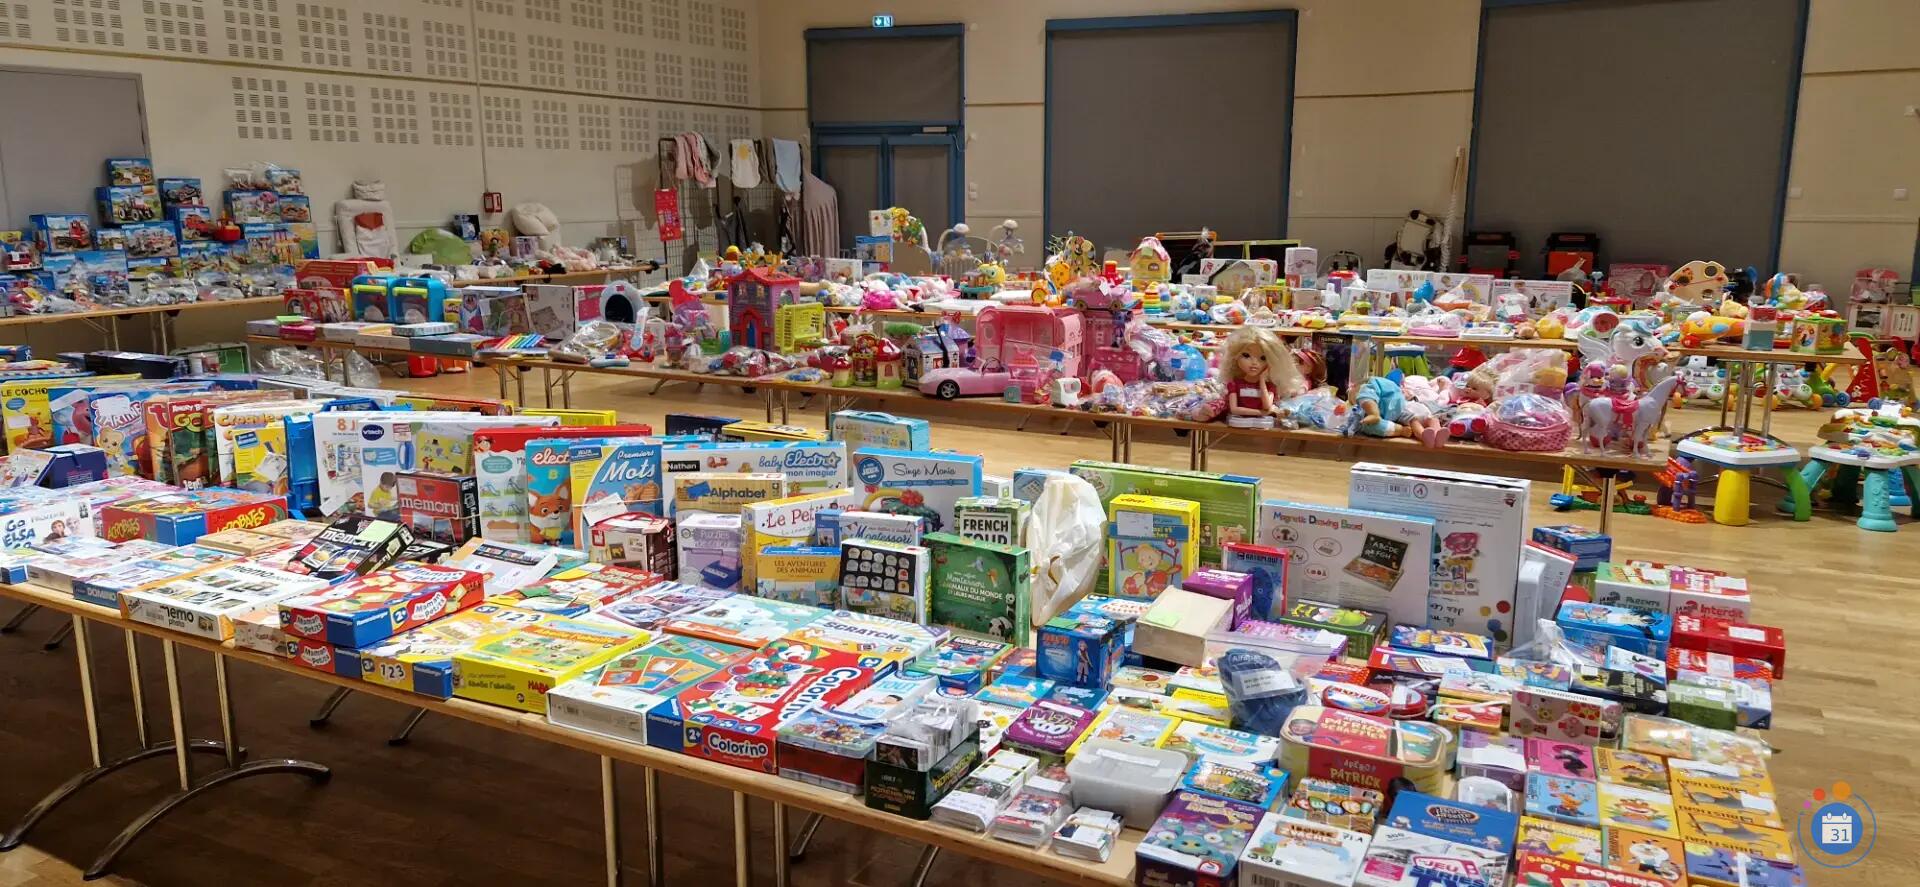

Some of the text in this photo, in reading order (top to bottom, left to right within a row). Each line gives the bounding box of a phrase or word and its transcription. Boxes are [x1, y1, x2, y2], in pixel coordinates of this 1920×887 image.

[617, 450, 655, 461] Premiers
[759, 455, 783, 473] baby
[600, 459, 655, 484] Mots
[668, 461, 697, 471] Nathan
[805, 469, 838, 479] imagier
[893, 463, 921, 478] Singe
[924, 463, 956, 476] Mania
[401, 497, 460, 519] memory
[767, 512, 787, 530] Le
[963, 519, 1009, 533] FRENCH
[2, 527, 36, 548] ELSA
[856, 526, 912, 544] Montessori
[980, 589, 1003, 600] MONDE
[1701, 604, 1743, 619] Interdit
[824, 620, 900, 640] SCRATCH
[709, 734, 769, 758] Colorino
[1329, 767, 1381, 789] PATRICK
[1427, 860, 1459, 873] JEU
[1575, 864, 1664, 887] DOMINO
